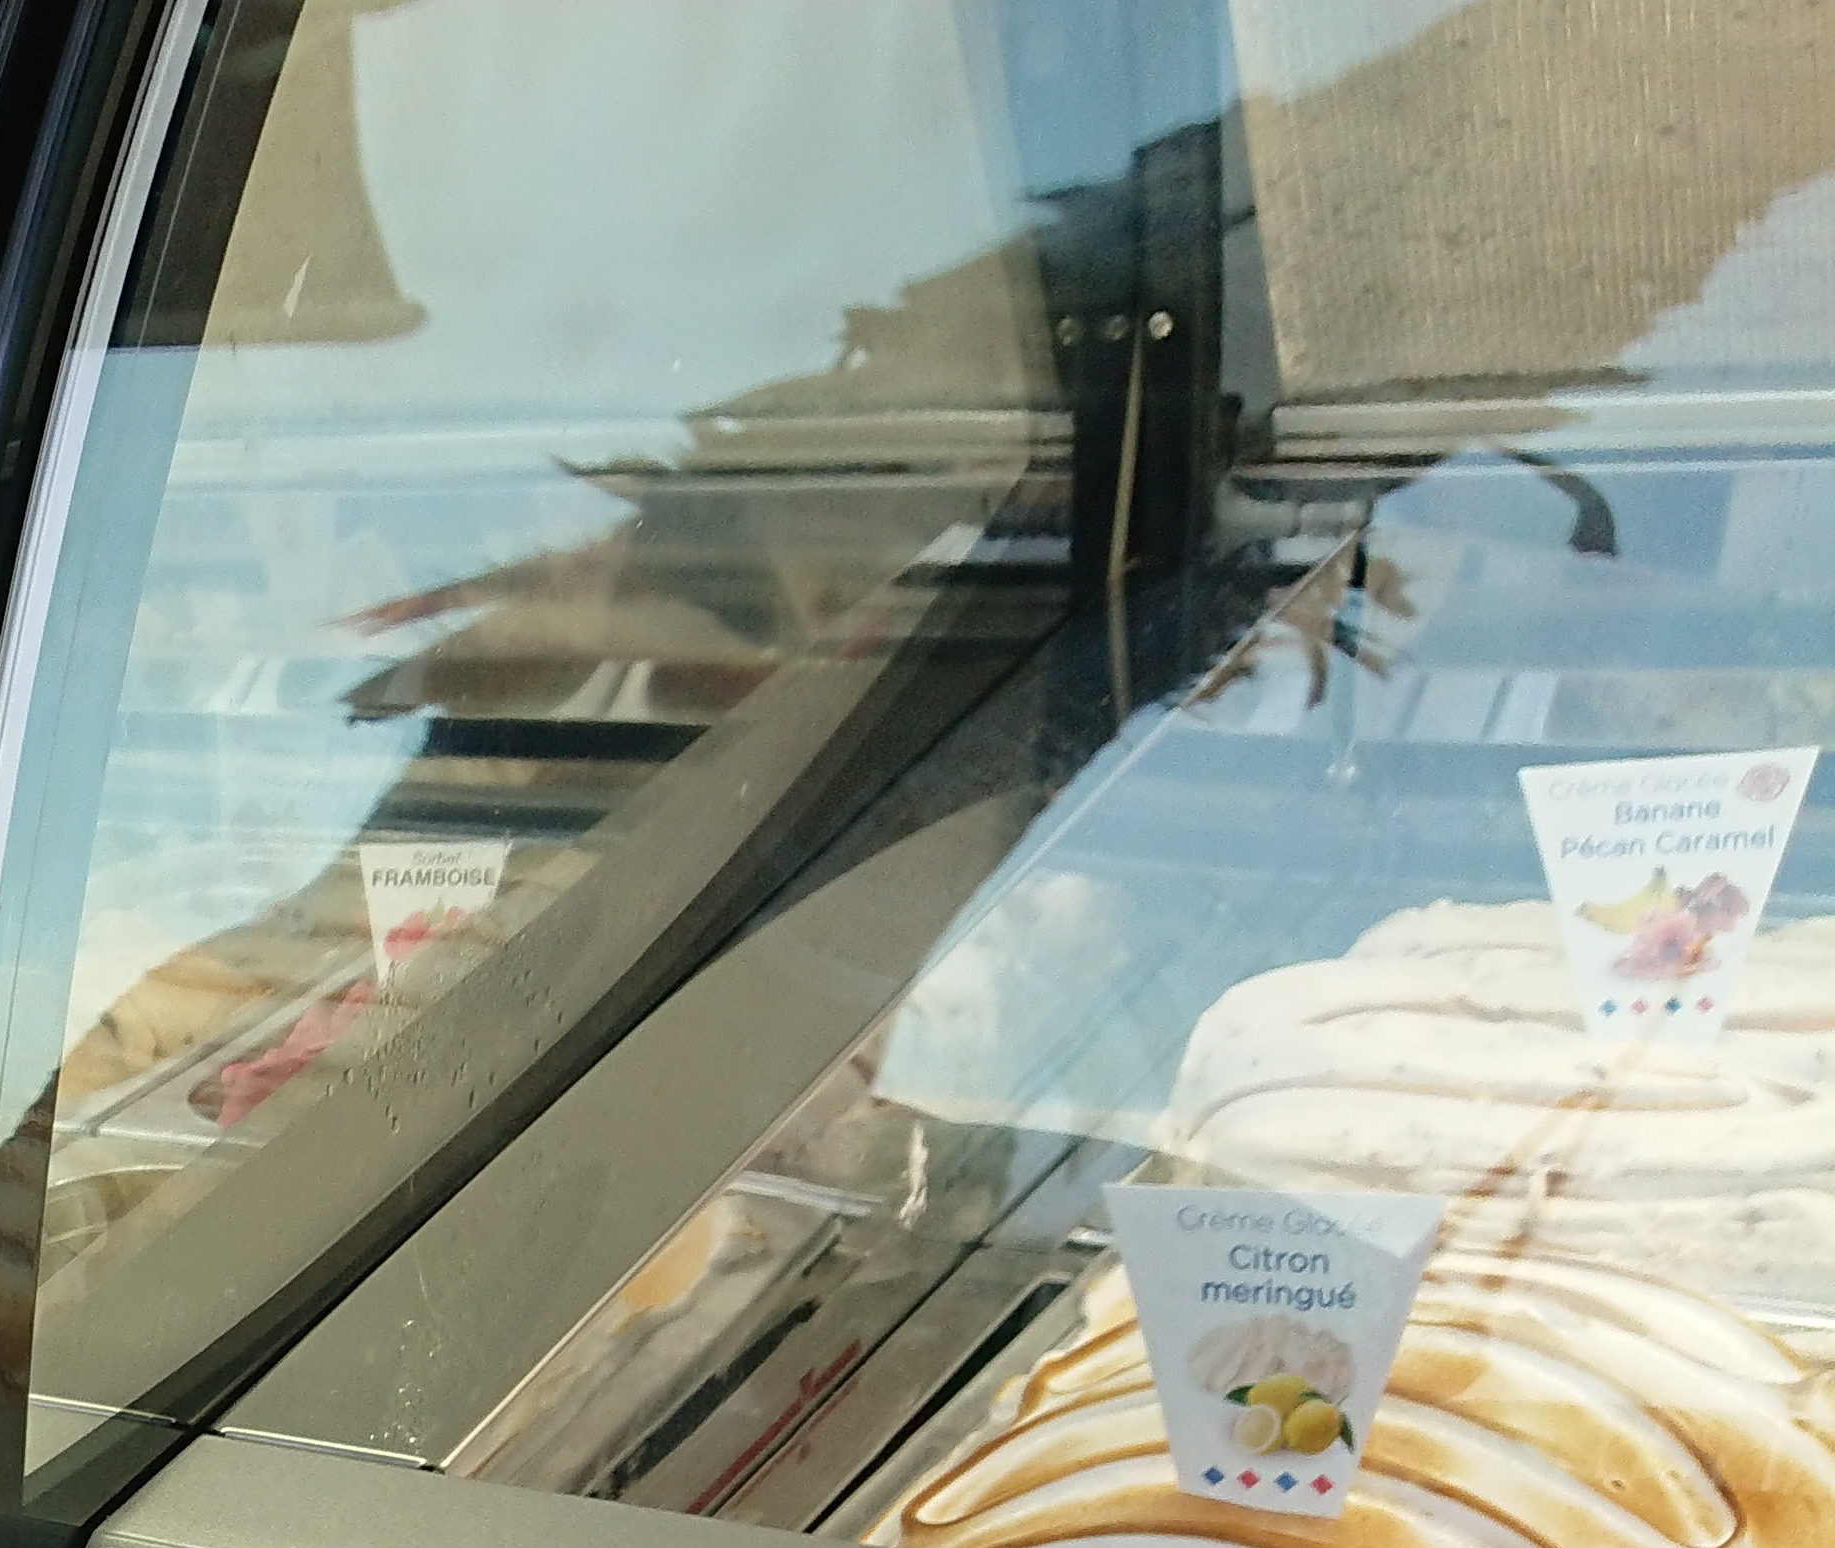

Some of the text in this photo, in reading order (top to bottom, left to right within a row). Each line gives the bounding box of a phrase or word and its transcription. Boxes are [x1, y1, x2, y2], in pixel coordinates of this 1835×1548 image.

[1614, 799, 1722, 826] Banane
[1559, 823, 1776, 860] Pécan Caramel
[411, 851, 462, 866] Sorbet
[371, 866, 496, 887] FRAMBOISE
[1228, 1241, 1332, 1276] Citron
[1200, 1277, 1358, 1312] meringué
